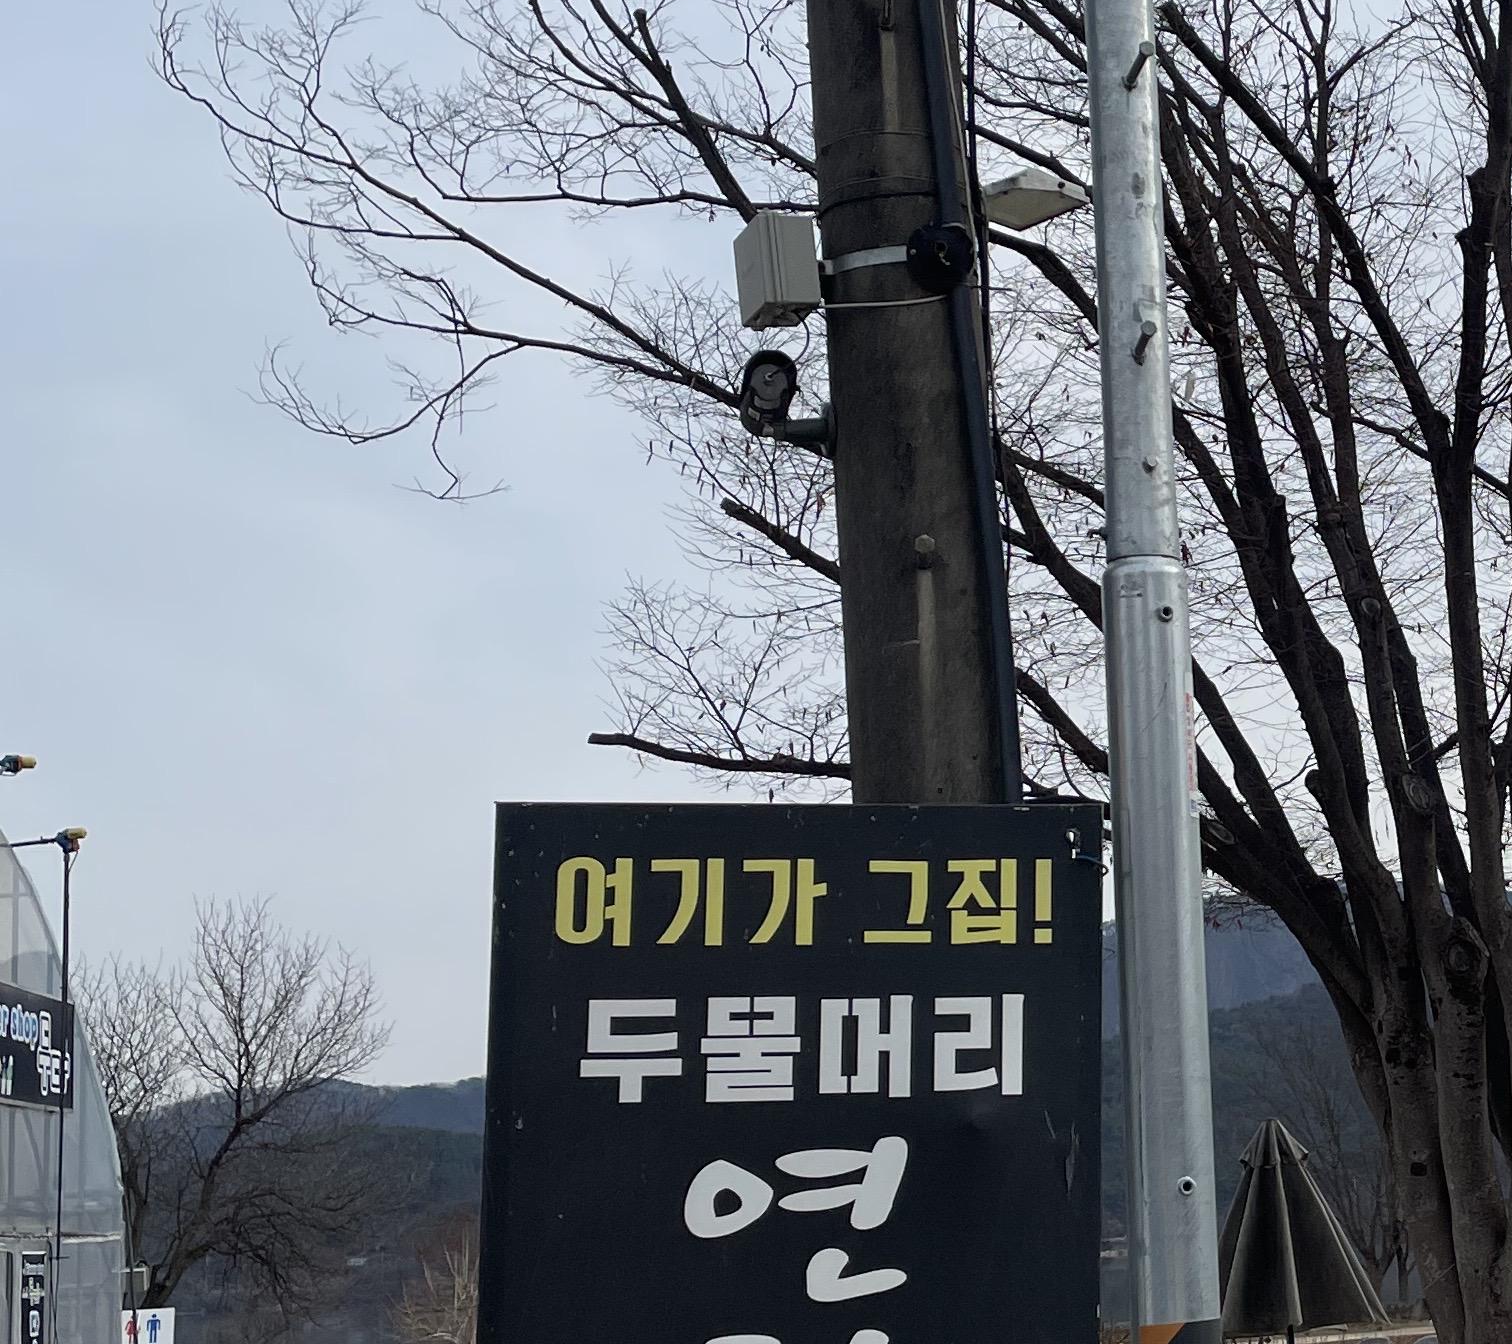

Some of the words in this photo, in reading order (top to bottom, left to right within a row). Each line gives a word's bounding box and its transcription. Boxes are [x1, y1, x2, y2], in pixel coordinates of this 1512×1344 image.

[555, 856, 828, 947] 여기가
[863, 858, 1053, 946] 그집!
[11, 1004, 38, 1051] shop
[579, 993, 1025, 1103] 두물머리
